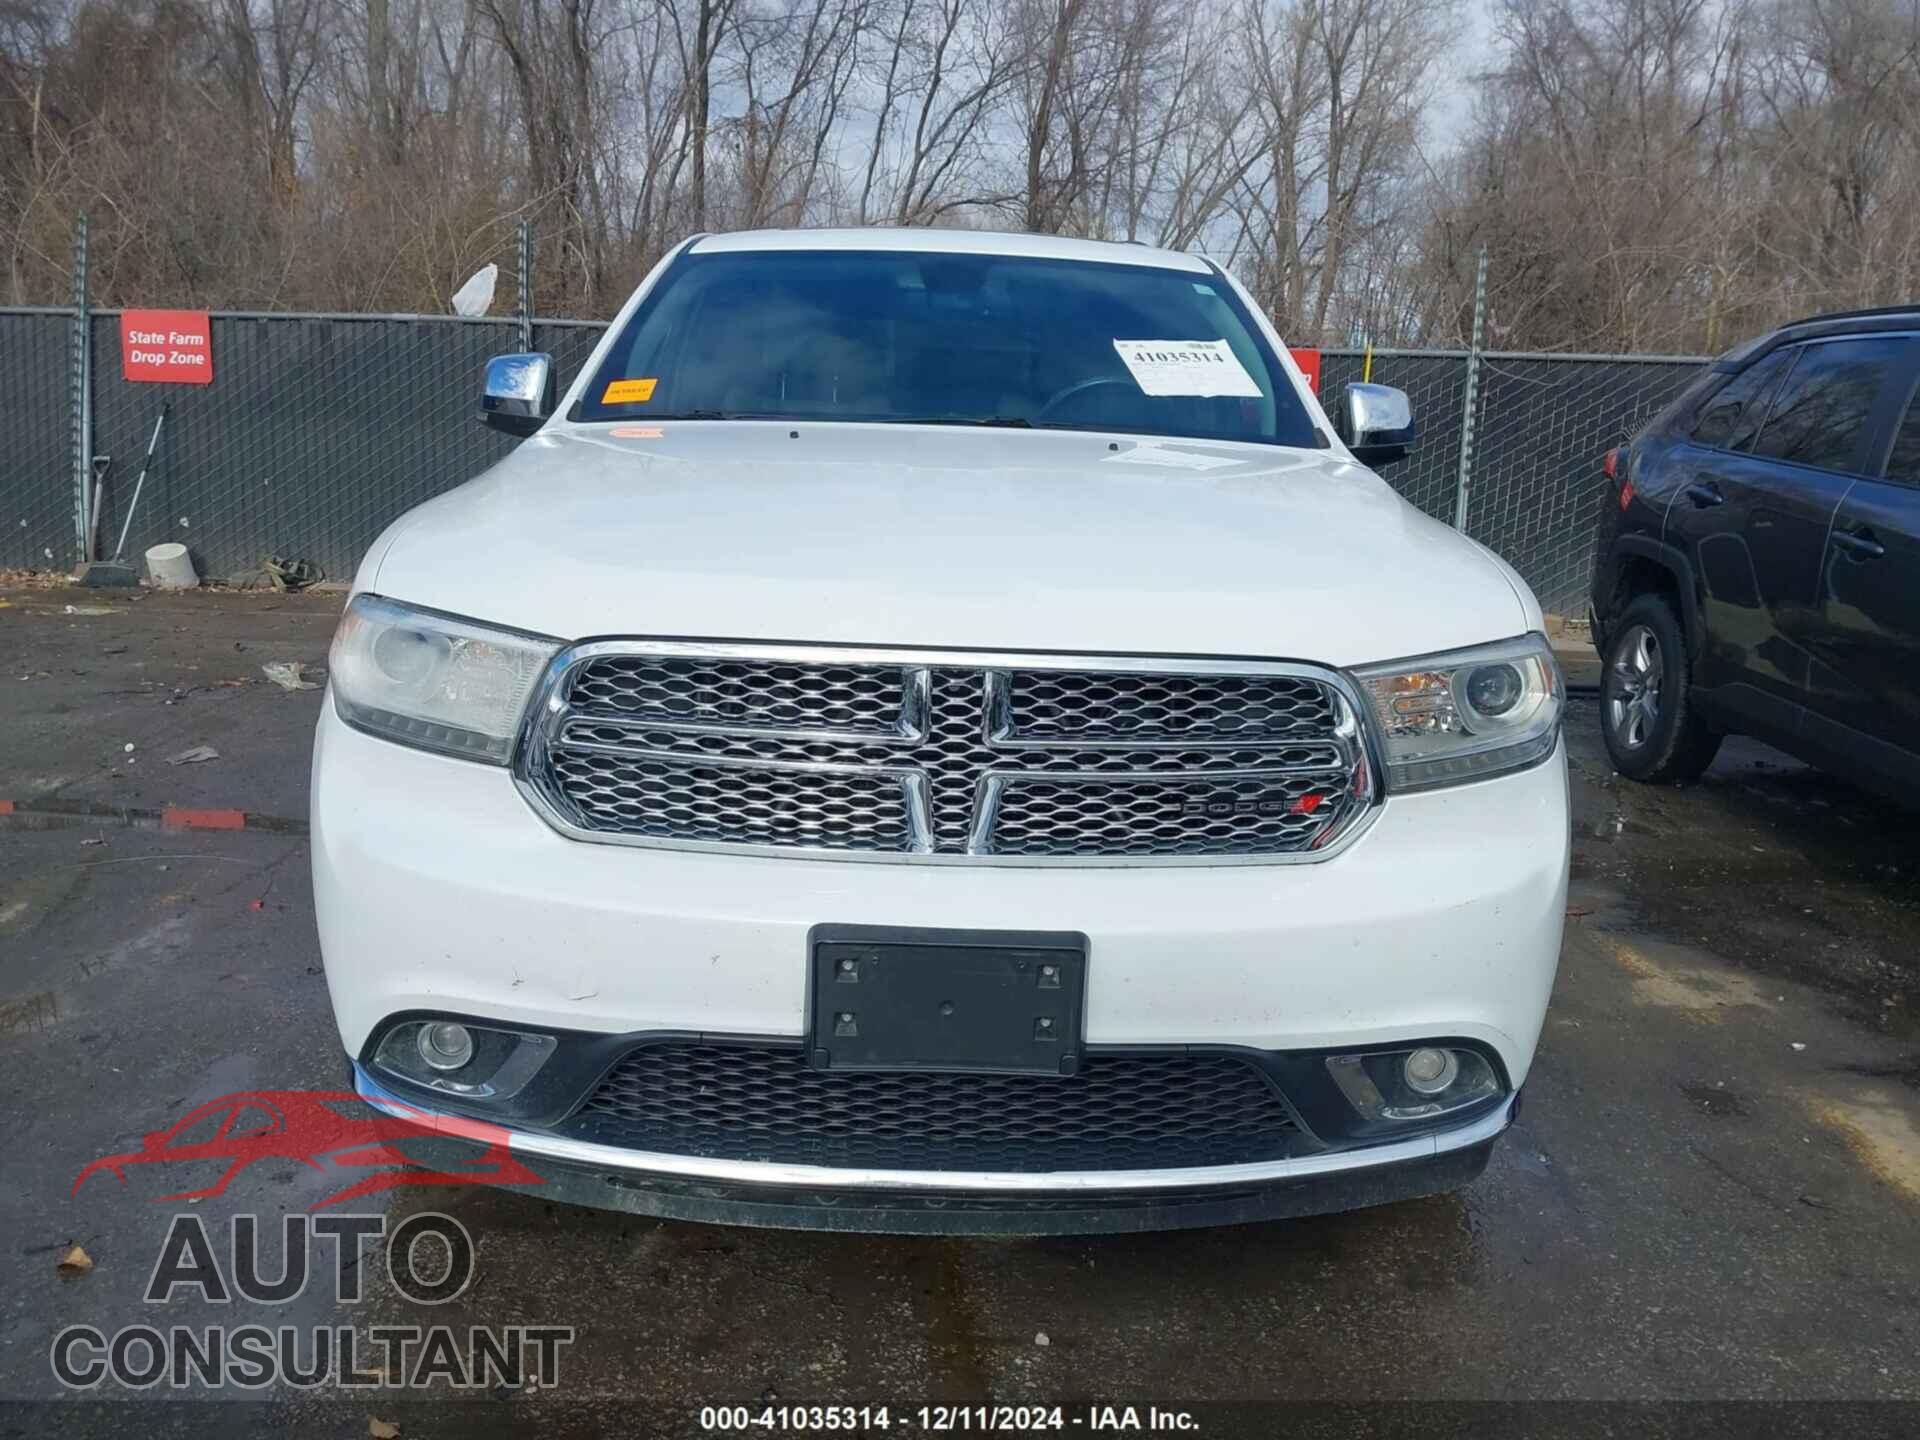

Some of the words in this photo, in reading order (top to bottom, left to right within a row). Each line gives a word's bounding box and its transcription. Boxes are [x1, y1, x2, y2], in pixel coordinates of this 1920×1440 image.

[128, 330, 165, 345] State
[169, 331, 204, 345] Farm
[131, 350, 165, 366] Drop
[169, 352, 205, 365] Zone
[1133, 351, 1226, 364] 41035314
